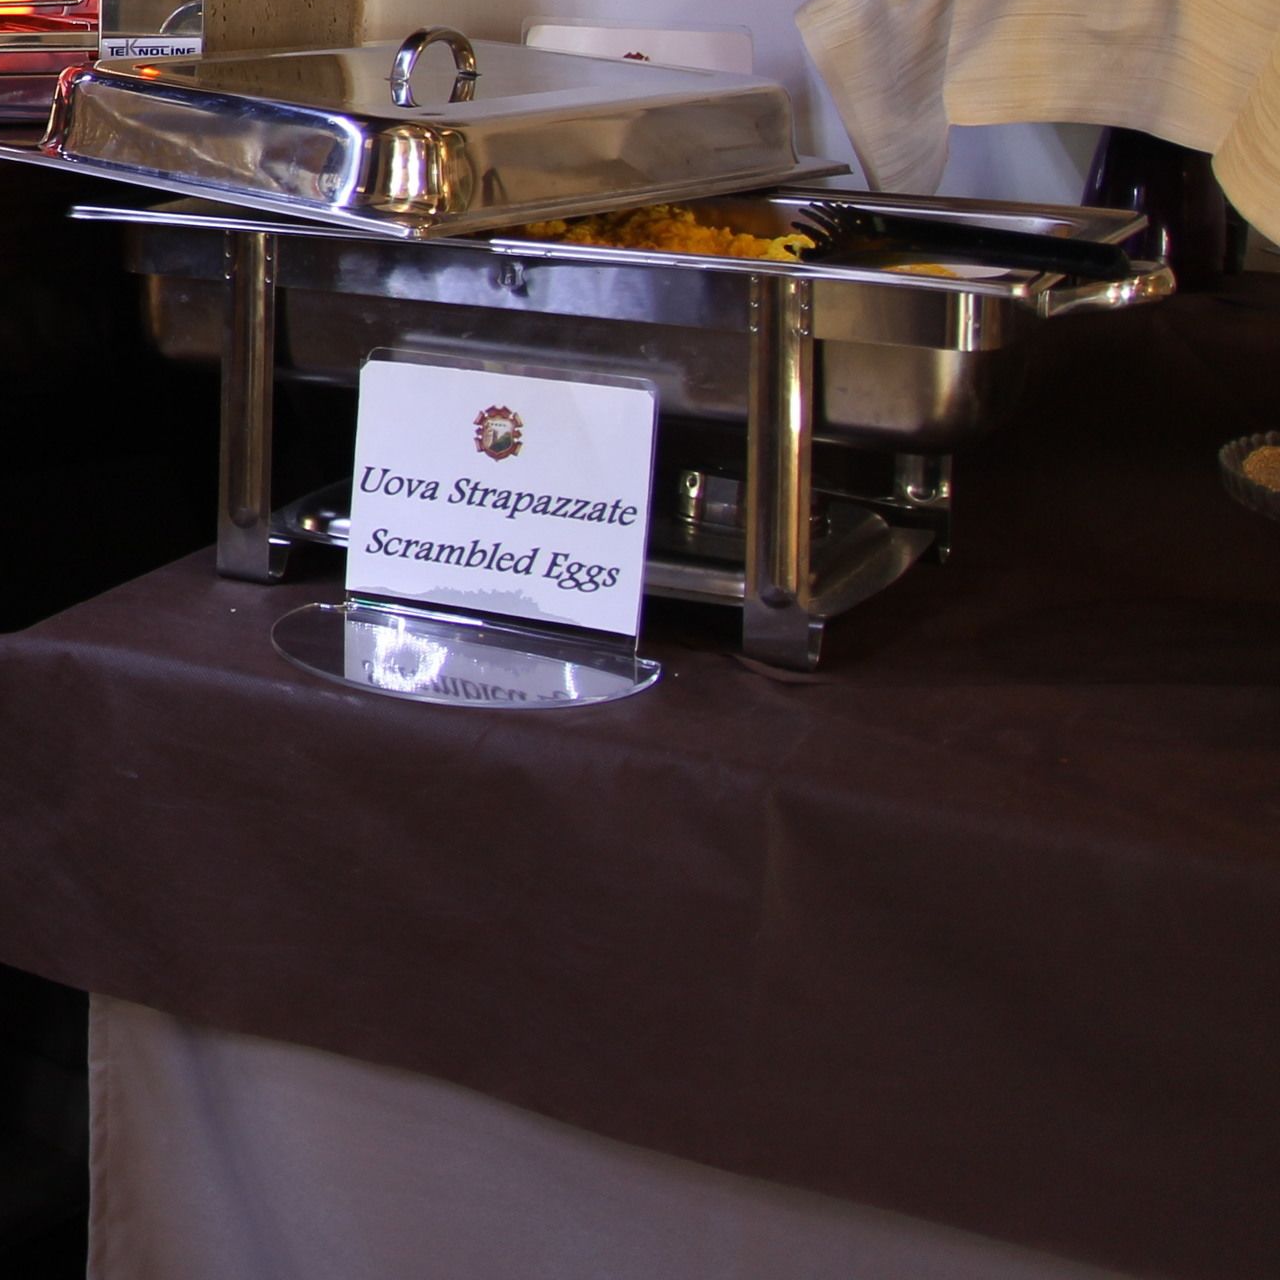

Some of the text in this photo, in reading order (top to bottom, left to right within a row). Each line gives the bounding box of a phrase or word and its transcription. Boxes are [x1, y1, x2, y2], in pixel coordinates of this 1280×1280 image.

[359, 466, 638, 526] Uova Strapazzate
[365, 527, 620, 593] Scrambled Eggs
